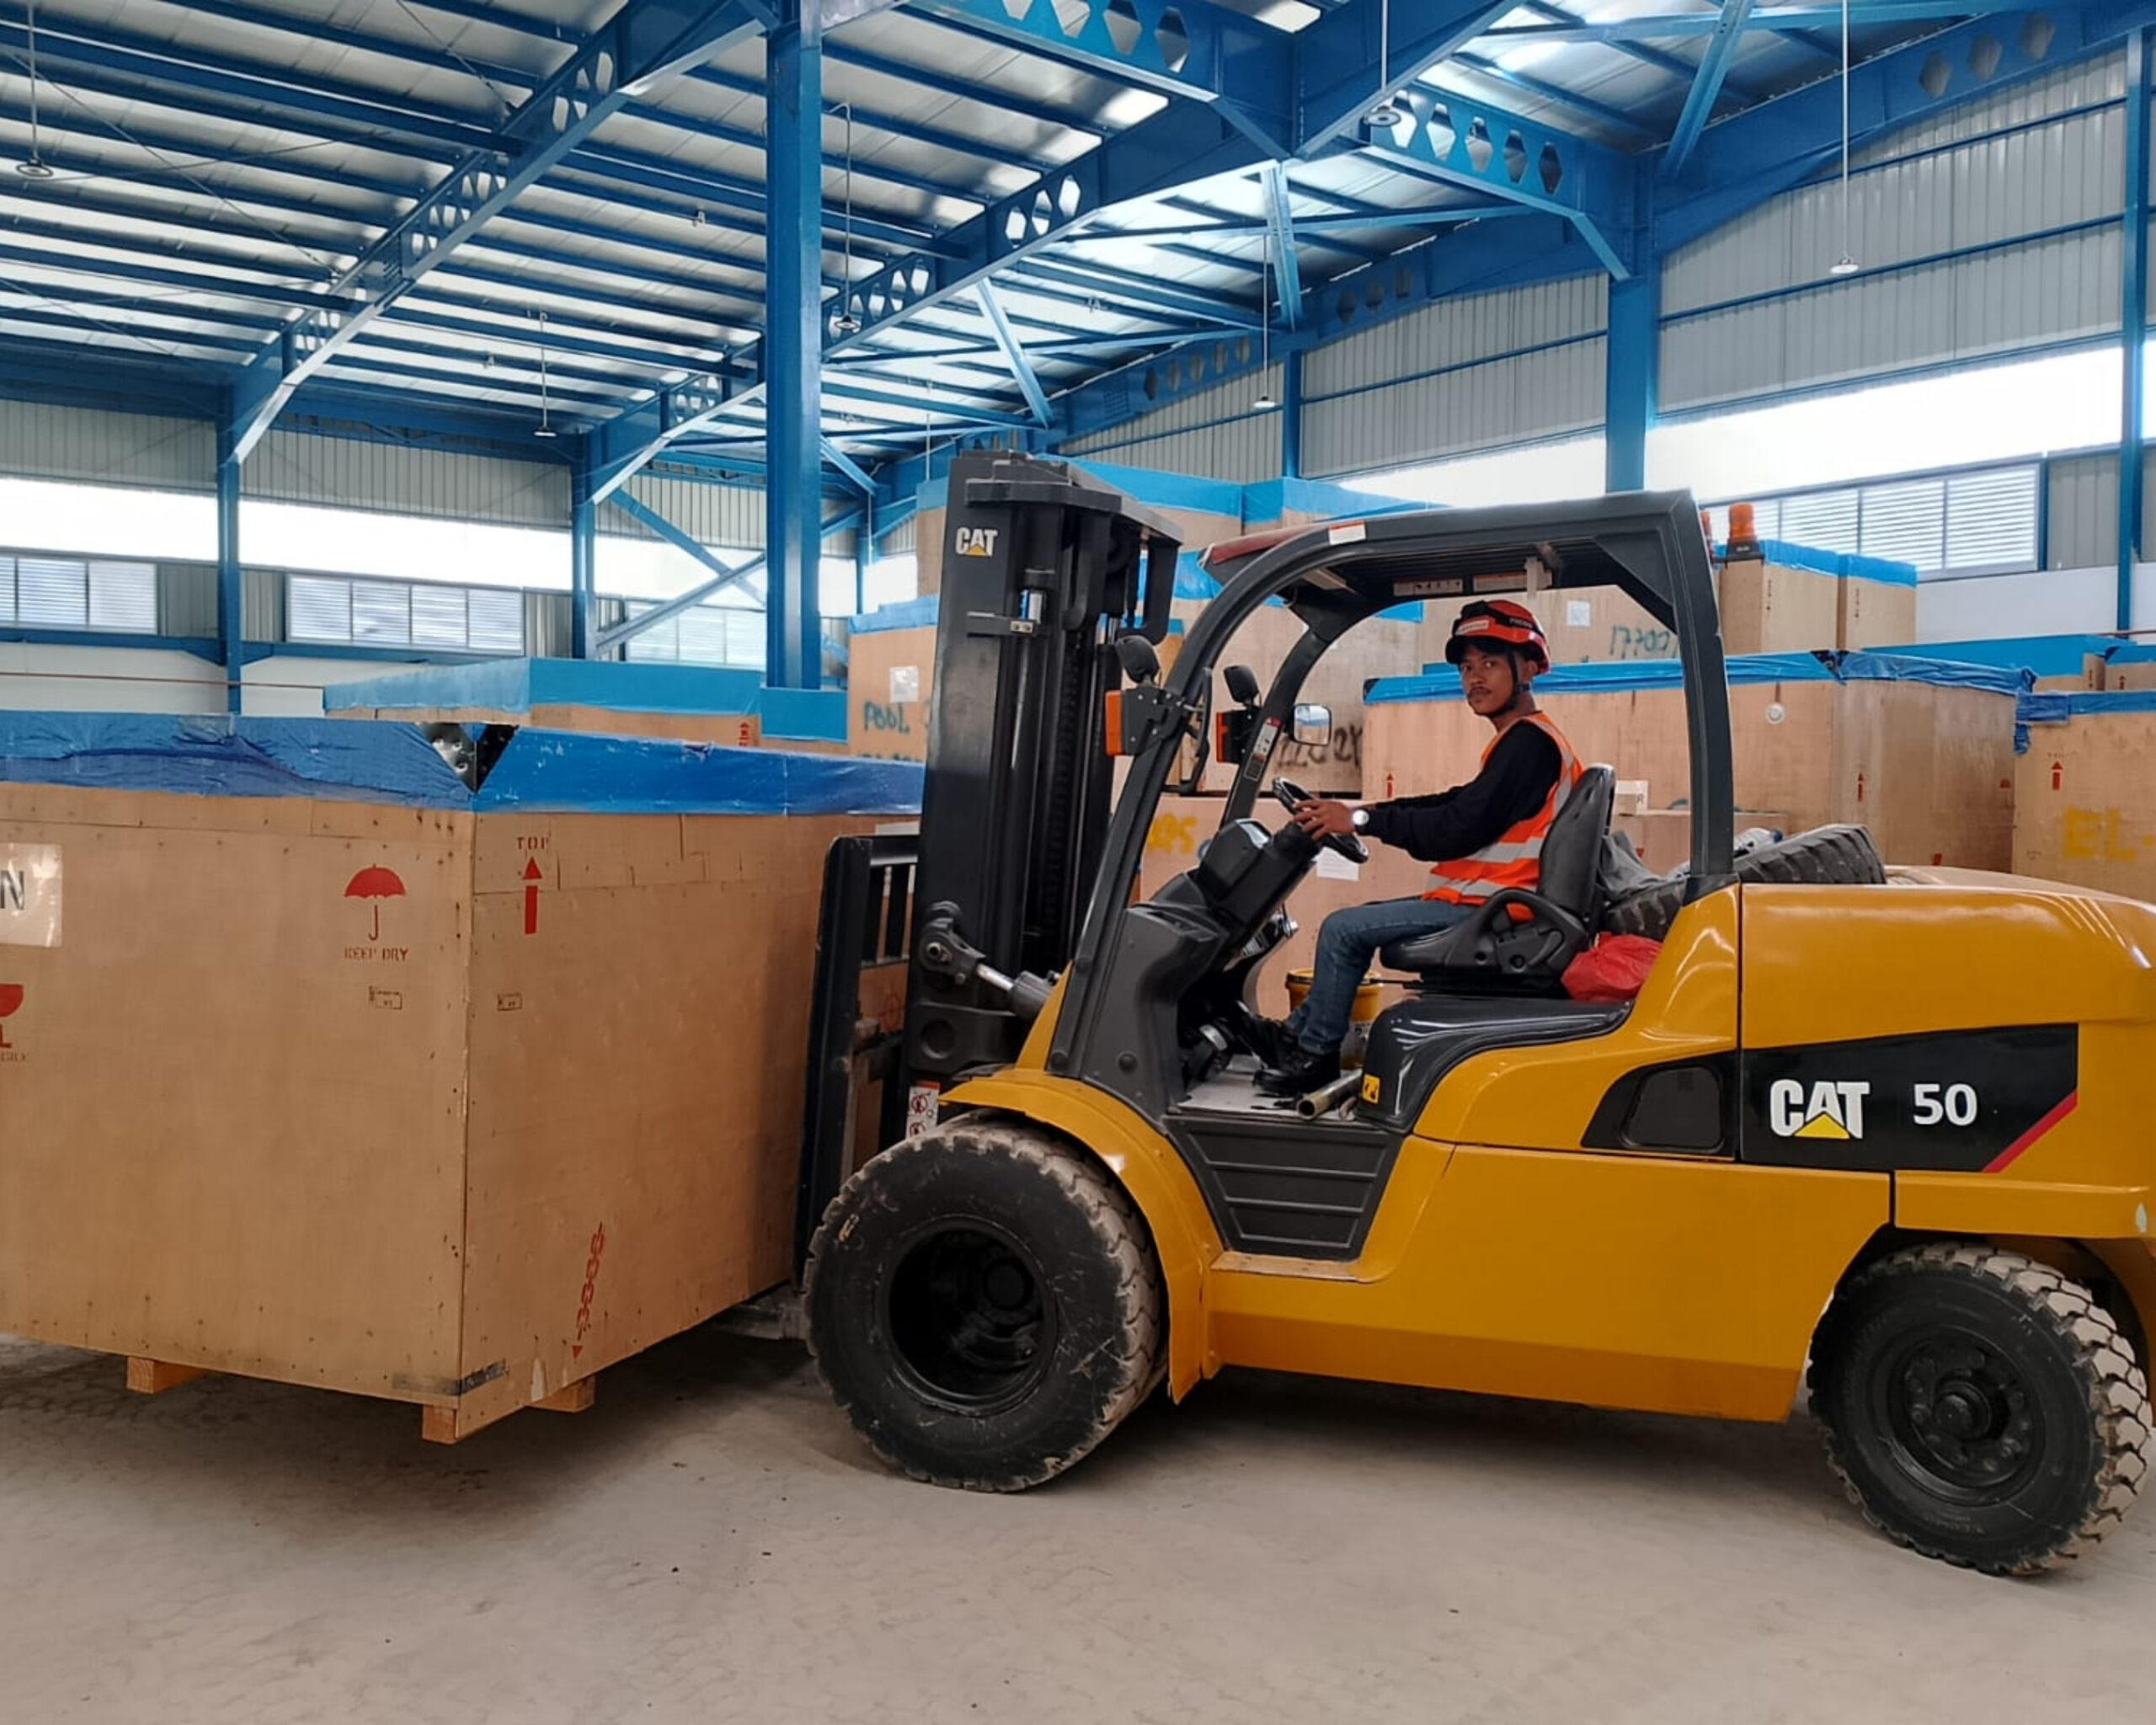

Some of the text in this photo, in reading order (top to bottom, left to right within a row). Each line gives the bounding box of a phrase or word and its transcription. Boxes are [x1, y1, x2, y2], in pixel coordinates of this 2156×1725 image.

[955, 526, 999, 556] CAT
[382, 947, 409, 962] DRY
[1770, 1079, 1978, 1139] CAT 50
